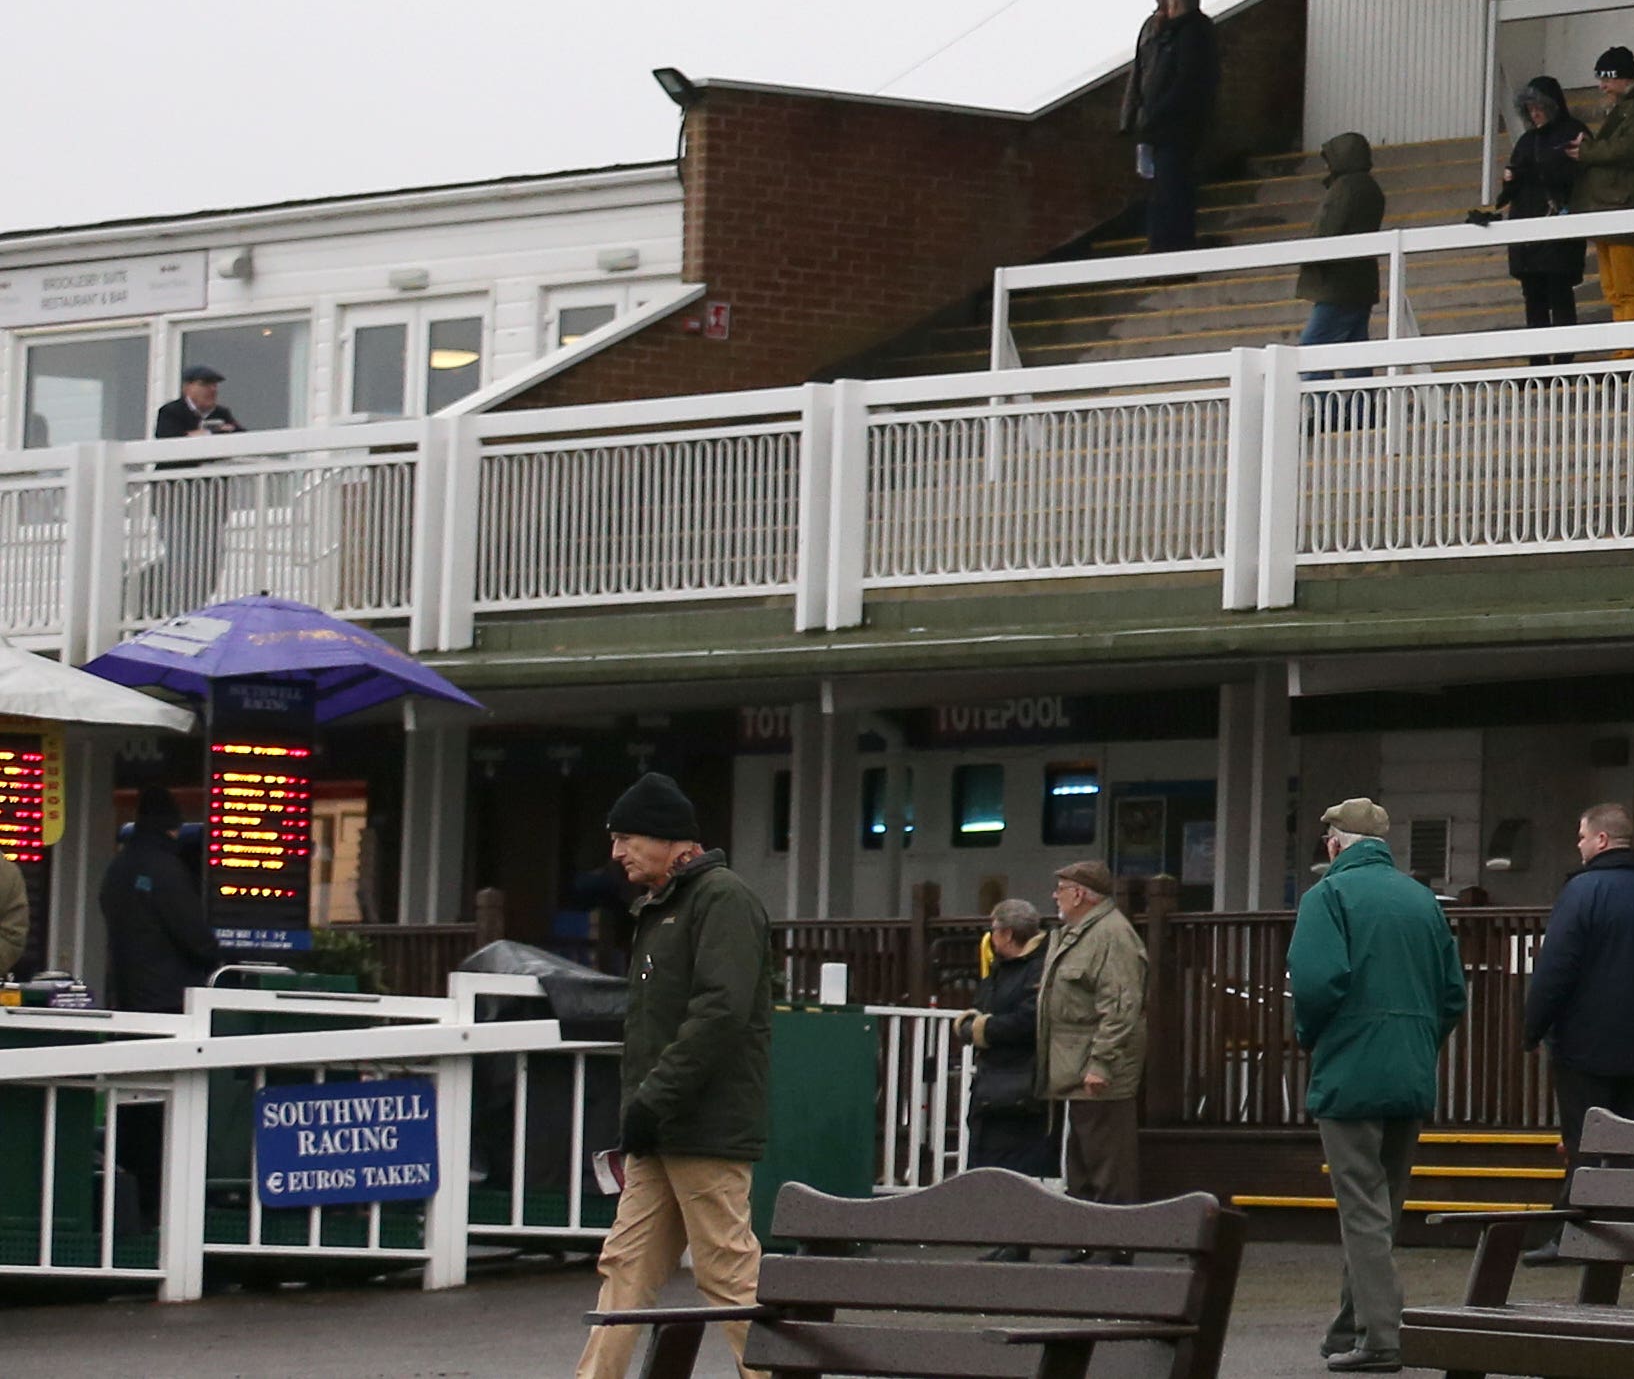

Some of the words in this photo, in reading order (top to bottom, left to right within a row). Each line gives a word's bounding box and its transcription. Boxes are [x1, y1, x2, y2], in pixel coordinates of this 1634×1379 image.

[110, 290, 128, 303] BAR
[263, 1095, 429, 1128] SOUTHWELL
[297, 1125, 399, 1157] RACING
[266, 1171, 285, 1194] €
[288, 1168, 356, 1193] EUROS
[363, 1163, 431, 1188] TAKEN
